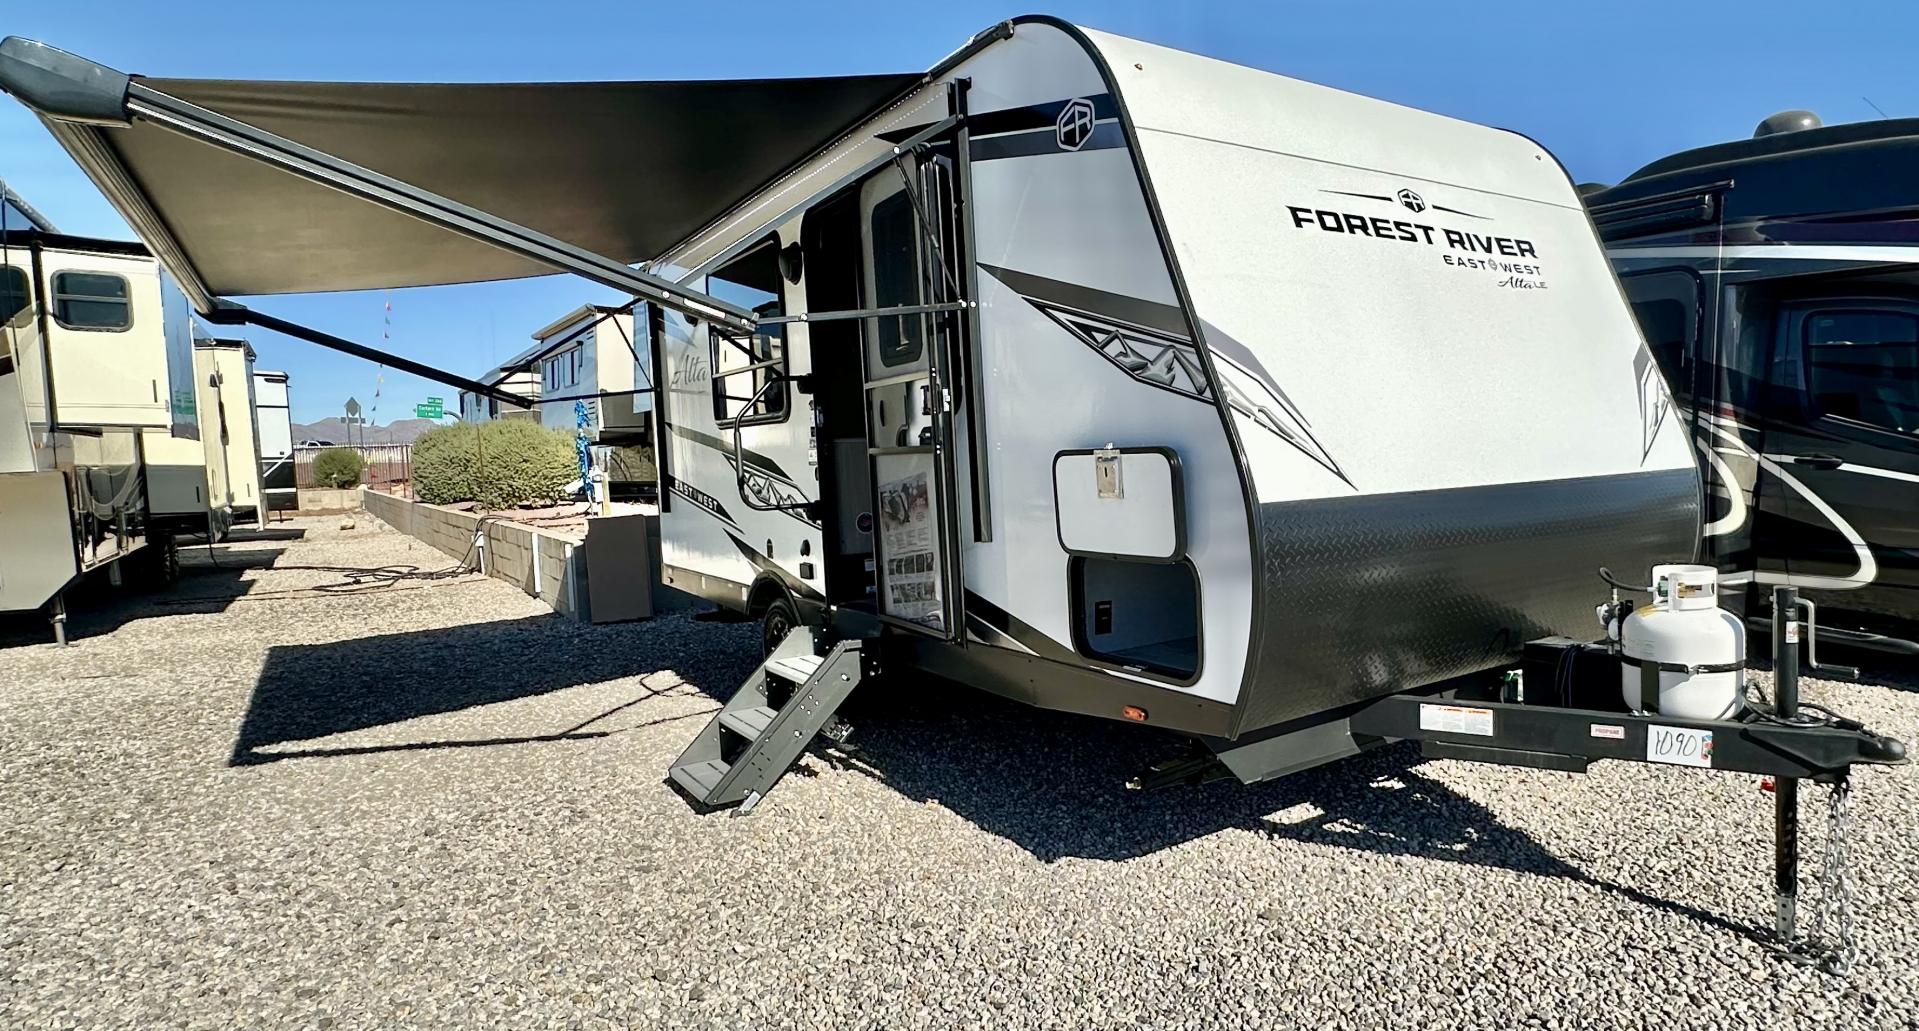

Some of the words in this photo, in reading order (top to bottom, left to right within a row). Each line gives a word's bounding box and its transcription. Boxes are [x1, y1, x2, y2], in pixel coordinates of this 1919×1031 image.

[1285, 204, 1435, 246] FOREST
[1441, 227, 1539, 259] RIVER
[1443, 254, 1486, 270] EAST
[1499, 262, 1541, 276] WEST
[1497, 276, 1534, 290] Alta
[670, 354, 708, 385] Alta
[675, 479, 693, 498] EAST
[697, 492, 718, 511] WEST
[1655, 730, 1698, 757] 1090
